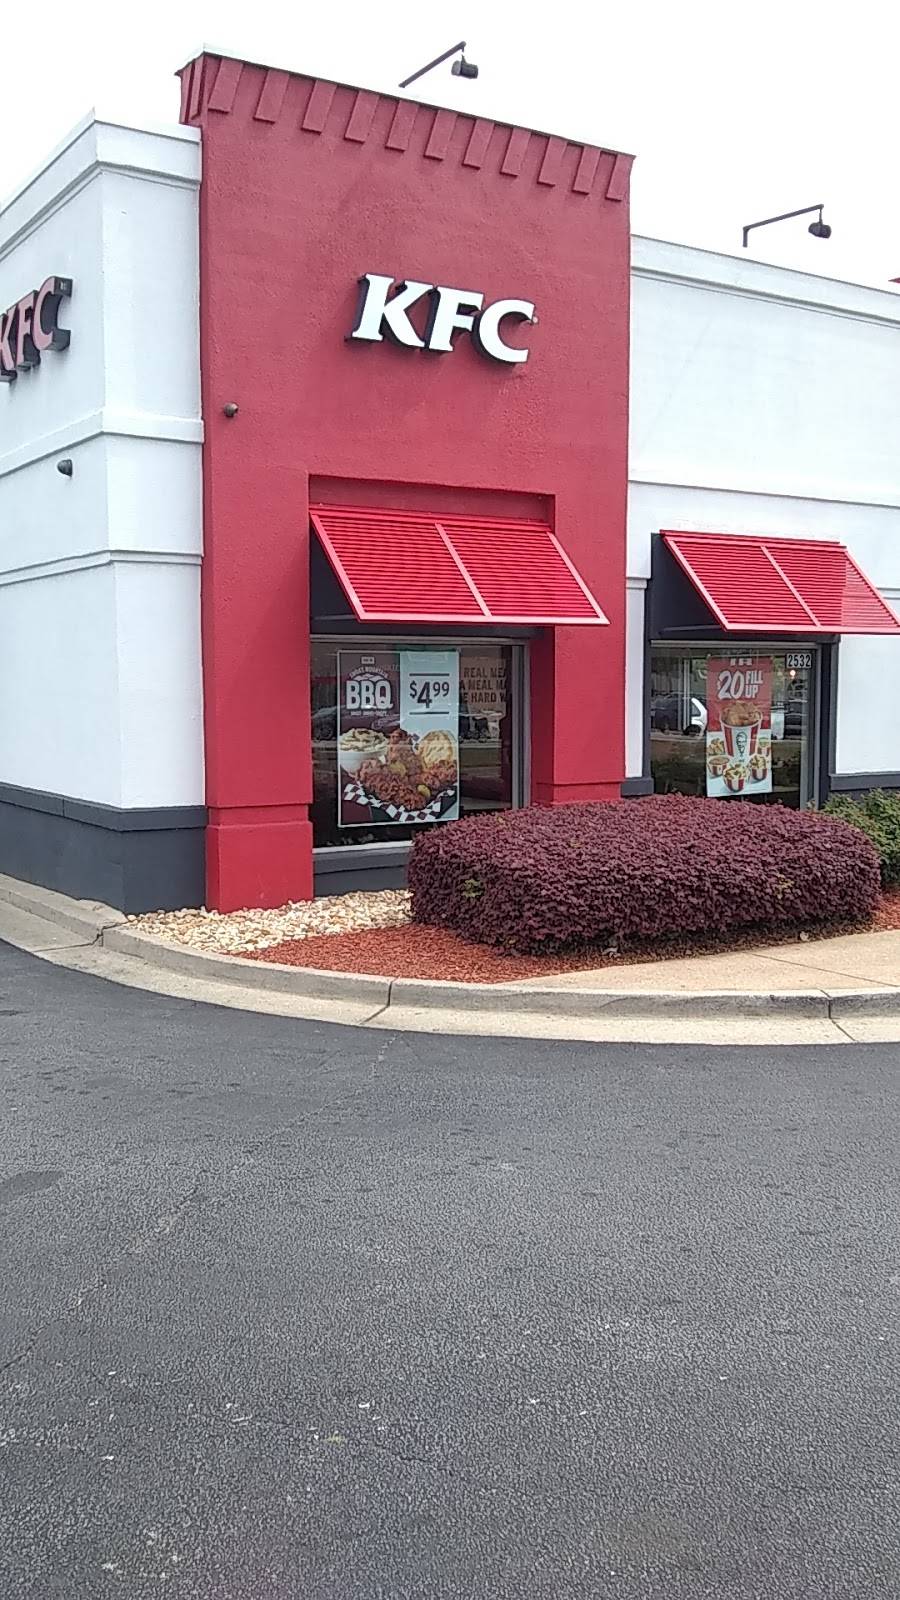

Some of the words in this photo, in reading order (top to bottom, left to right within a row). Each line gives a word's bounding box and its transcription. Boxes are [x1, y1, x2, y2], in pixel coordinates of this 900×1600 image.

[351, 273, 535, 363] KFC
[787, 654, 811, 668] 2532
[464, 667, 487, 678] REAL
[745, 670, 763, 684] FILL
[468, 679, 494, 690] MEAL
[346, 680, 394, 709] BBQ
[471, 692, 497, 703] HARD
[745, 685, 759, 699] UP
